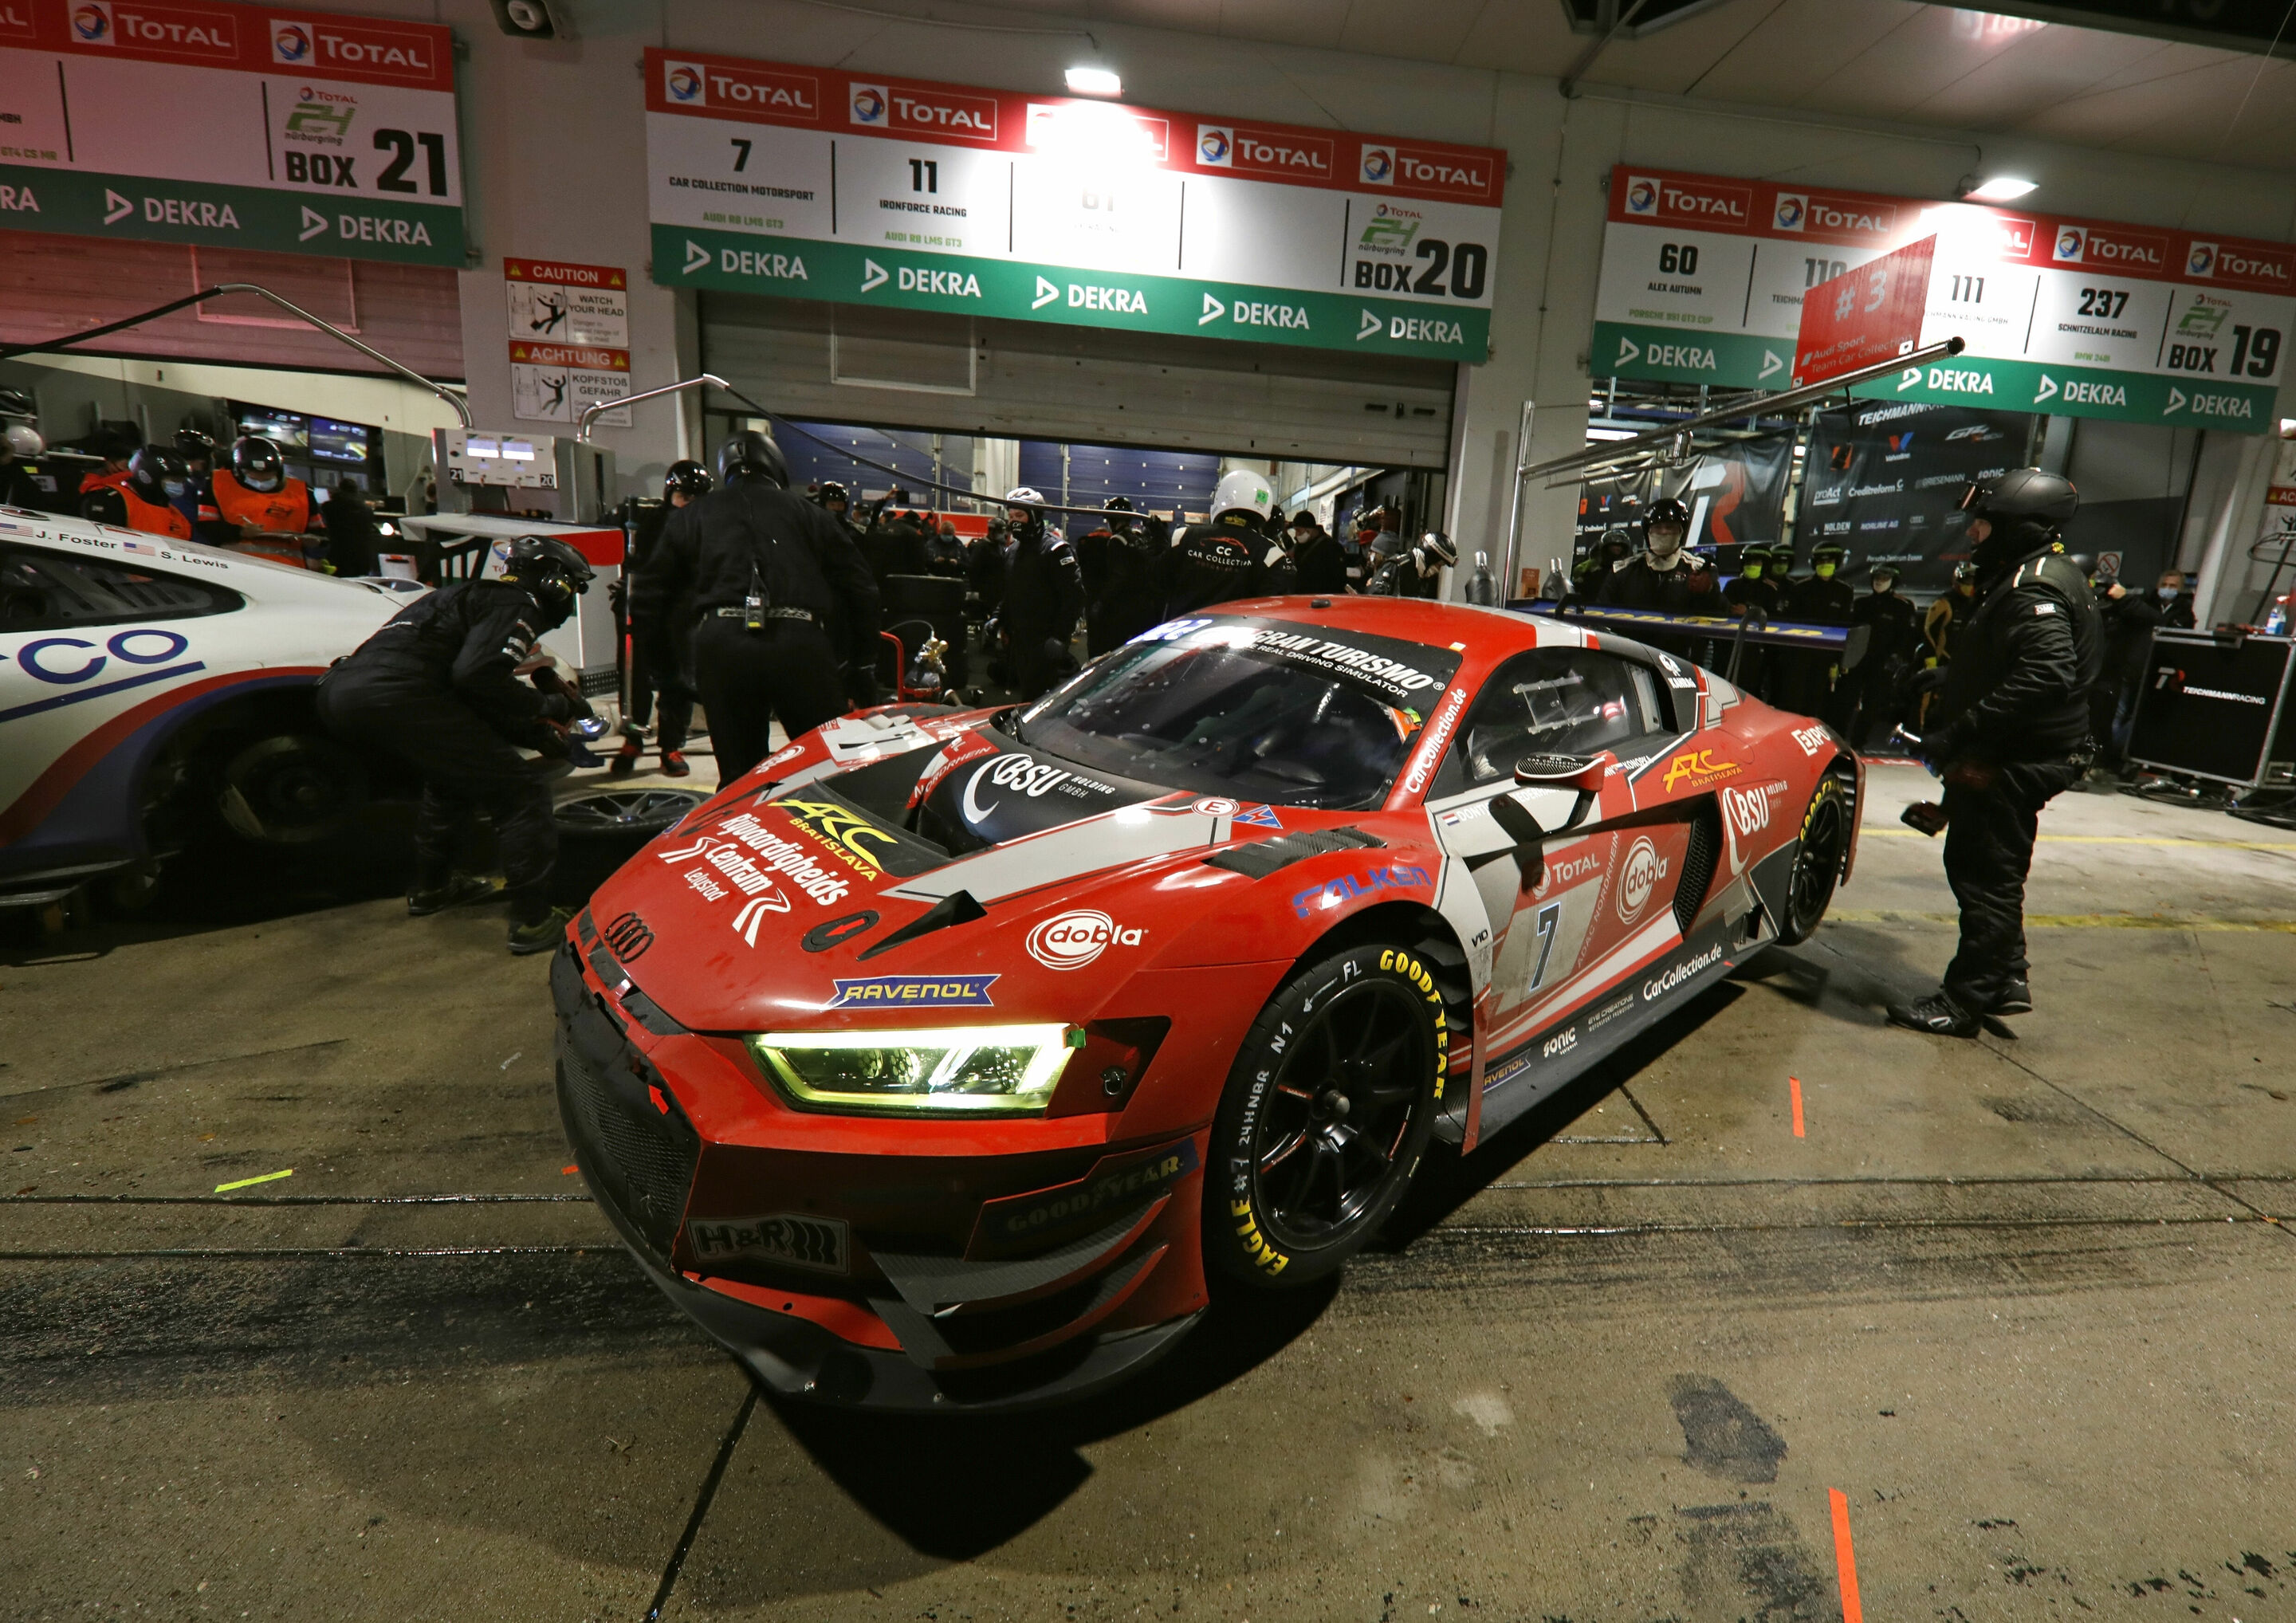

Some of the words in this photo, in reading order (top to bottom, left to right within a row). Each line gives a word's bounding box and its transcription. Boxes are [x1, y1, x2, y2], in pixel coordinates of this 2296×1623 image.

[117, 14, 232, 48] TOTAL
[320, 34, 428, 68] TOTAL
[316, 91, 357, 104] TOTAL
[711, 76, 812, 108] TOTAL
[893, 96, 991, 129] TOTAL
[285, 151, 358, 188] BOX
[373, 128, 447, 197] 21
[731, 138, 752, 172] 7
[1237, 139, 1327, 170] TOTAL
[909, 158, 938, 194] 11
[1400, 159, 1486, 187] TOTAL
[669, 176, 690, 188] CAR
[692, 179, 749, 195] COLLECTION
[750, 186, 815, 201] MOTORSPORT
[144, 197, 240, 229] DEKRA
[879, 199, 930, 214] IRONFORCE
[933, 205, 967, 218] RACING
[1390, 207, 1423, 219] TOTAL
[1664, 189, 1744, 217] TOTAL
[339, 216, 432, 246] DEKRA
[703, 212, 726, 224] AUDI
[744, 216, 763, 228] LMS
[765, 218, 784, 229] GT3
[1811, 205, 1889, 233] TOTAL
[885, 231, 907, 242] AUDI
[924, 235, 943, 246] LMS
[945, 238, 962, 248] GT3
[1358, 244, 1406, 256] nürburgring
[2090, 237, 2161, 264] TOTAL
[721, 249, 808, 281] DEKRA
[1354, 261, 1413, 293] BOX
[1413, 238, 1488, 299] 20
[1659, 243, 1699, 276] 60
[2220, 253, 2288, 279] TOTAL
[533, 265, 599, 283] CAUTION
[898, 267, 981, 297] DEKRA
[579, 295, 613, 305] WATCH
[1068, 285, 1148, 314] DEKRA
[1648, 282, 1668, 293] ALEX
[1669, 285, 1703, 296] AUTUMN
[1835, 286, 1856, 322] #
[1865, 269, 1887, 313] 3
[1952, 275, 1984, 303] 111
[2206, 297, 2231, 307] TOTAL
[568, 305, 595, 315] YOUR
[597, 307, 624, 316] HEAD
[1234, 302, 1310, 330] DEKRA
[1629, 308, 1664, 320] PORSCHE
[1697, 315, 1714, 324] CUP
[2078, 288, 2129, 319] 237
[1390, 318, 1464, 344] DEKRA
[2058, 323, 2109, 336] SCHNITZELALM
[2111, 328, 2138, 339] RACING
[531, 347, 611, 366] ACHTUNG
[1647, 344, 1716, 370] DEKRA
[1812, 357, 1837, 374] Team
[1839, 352, 1856, 365] Car
[1857, 334, 1913, 359] Collection
[1813, 346, 1835, 360] Audi
[1837, 335, 1866, 353] Sport
[2168, 344, 2219, 373] BOX
[2230, 324, 2282, 378] 19
[580, 386, 622, 397] GEFAHR
[1928, 367, 1994, 394] DEKRA
[2064, 381, 2126, 407] DEKRA
[2192, 394, 2252, 419] DEKRA
[450, 468, 463, 481] 21
[541, 475, 554, 487] 20
[1849, 484, 1896, 497] Creditreform
[36, 531, 52, 540] J.
[59, 532, 118, 549] Foster
[1216, 546, 1233, 556] CC
[160, 551, 177, 560] S.
[183, 554, 230, 569] Lewis
[1187, 549, 1202, 559] CAR
[1254, 630, 1308, 651] GRAN
[1309, 641, 1434, 690] TURISMO
[1257, 644, 1284, 657] REAL
[1287, 650, 1334, 669] DRIVING
[1334, 664, 1409, 698] SIMULATOR
[1406, 688, 1467, 794] CarCollection.de
[914, 745, 993, 799] NORDRHEIN
[1071, 775, 1116, 795] HOLDING
[1692, 767, 1744, 788] BRATISLAVA
[1058, 783, 1089, 799] GMBH
[1204, 801, 1226, 813] E
[705, 843, 773, 896] Centrum
[1552, 853, 1600, 884] TOTAL
[1594, 830, 1620, 922] NORDRHEIN
[1627, 856, 1668, 895] dobla
[683, 867, 729, 902] Lelystad
[1049, 924, 1143, 947] dobla
[1529, 901, 1561, 992] 7
[1343, 960, 1362, 983] FL
[1642, 942, 1723, 1002] CarCollection.de
[843, 983, 979, 1000] RAVENOL
[1601, 992, 1634, 1018] CREATIONS
[1484, 1057, 1524, 1088] AVENOL
[696, 1220, 792, 1256] H&R
[1231, 1199, 1290, 1276] EAGLE
